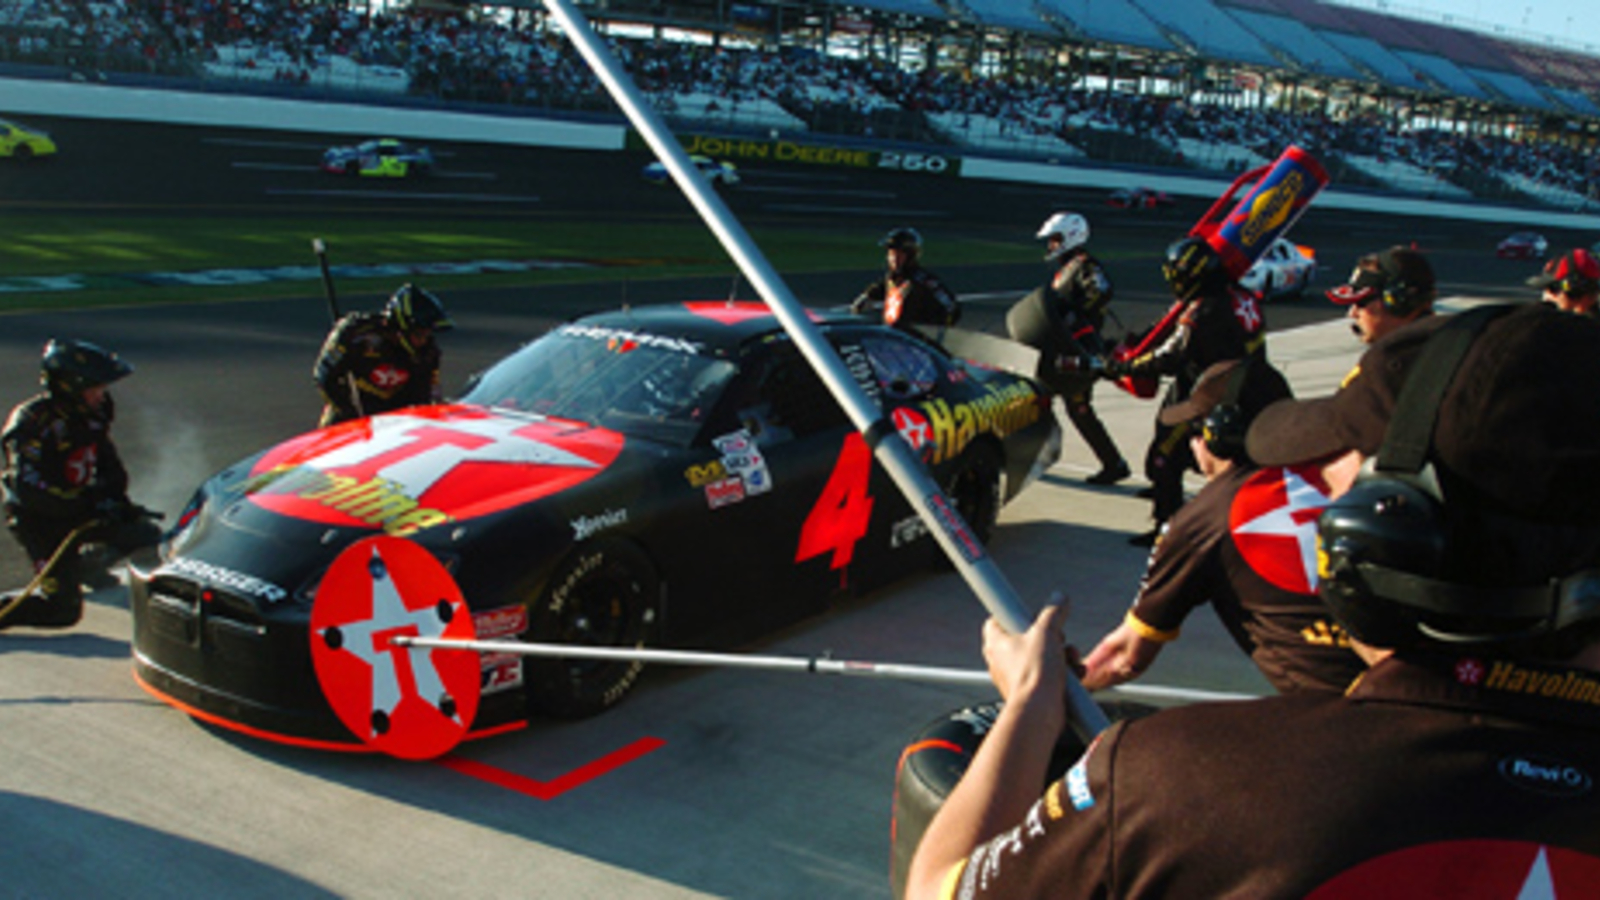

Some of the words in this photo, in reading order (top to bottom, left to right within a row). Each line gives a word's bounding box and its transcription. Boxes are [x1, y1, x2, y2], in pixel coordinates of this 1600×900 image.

[686, 134, 768, 157] JOHN
[774, 141, 870, 167] DEERE
[877, 150, 948, 172] 250
[1240, 169, 1304, 247] SUNOCO
[921, 379, 1040, 466] Havoline
[793, 431, 876, 571] 4
